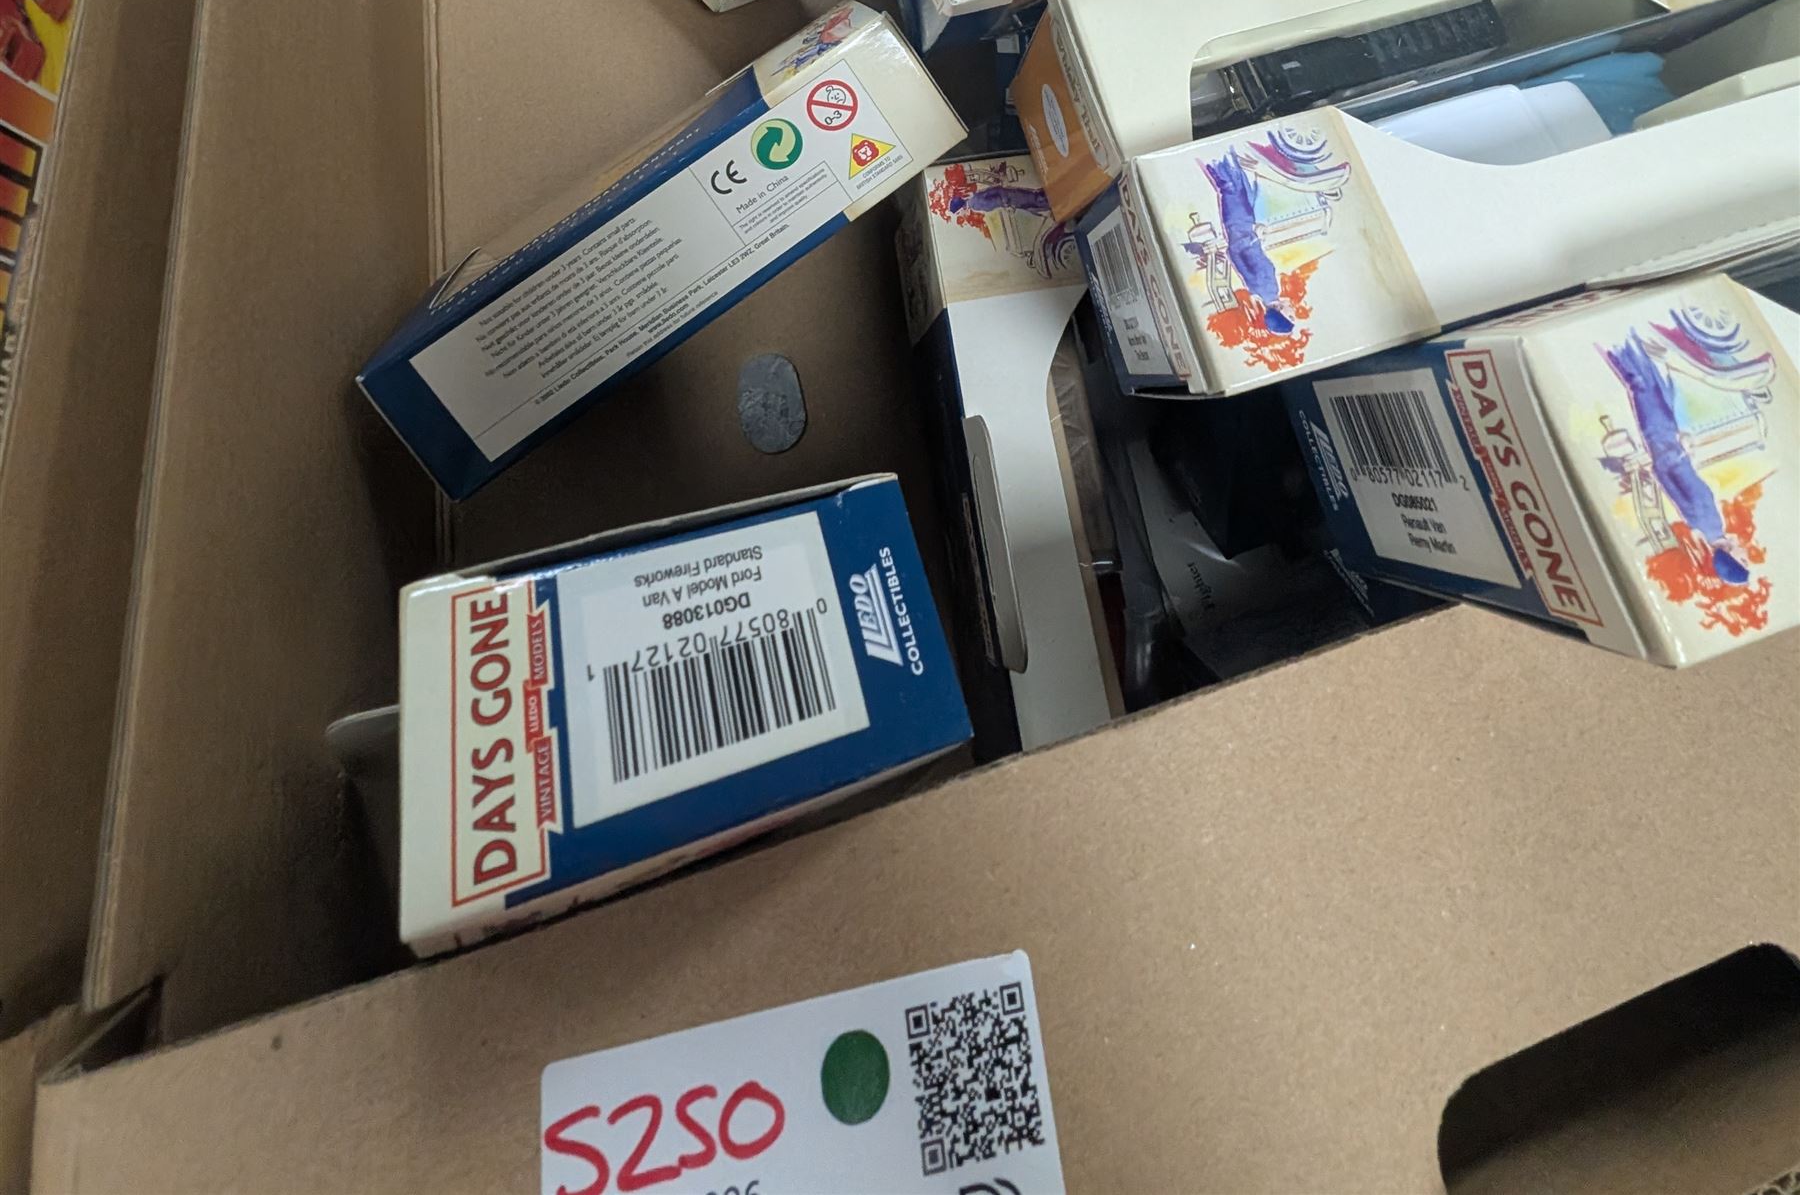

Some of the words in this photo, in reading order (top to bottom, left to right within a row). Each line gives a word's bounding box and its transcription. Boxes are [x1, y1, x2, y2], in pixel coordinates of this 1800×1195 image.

[823, 109, 843, 126] 0-3
[734, 194, 758, 214] Made
[764, 172, 789, 193] China
[1462, 360, 1521, 468] DAYS
[1510, 481, 1586, 612] GONE
[633, 558, 701, 592] Fireworks
[703, 542, 763, 575] Standard
[730, 563, 762, 588] Ford
[641, 589, 669, 611] Van
[685, 572, 729, 600] Model
[661, 589, 751, 632] DG013088
[717, 607, 791, 647] 80577
[849, 563, 904, 667] LLEDO
[879, 546, 924, 676] COLLECTIBLES
[470, 592, 513, 727] GONE
[530, 616, 547, 681] MODELS
[628, 630, 707, 673] 02127
[535, 743, 553, 820] VINTAGE
[471, 737, 518, 886] DAYS
